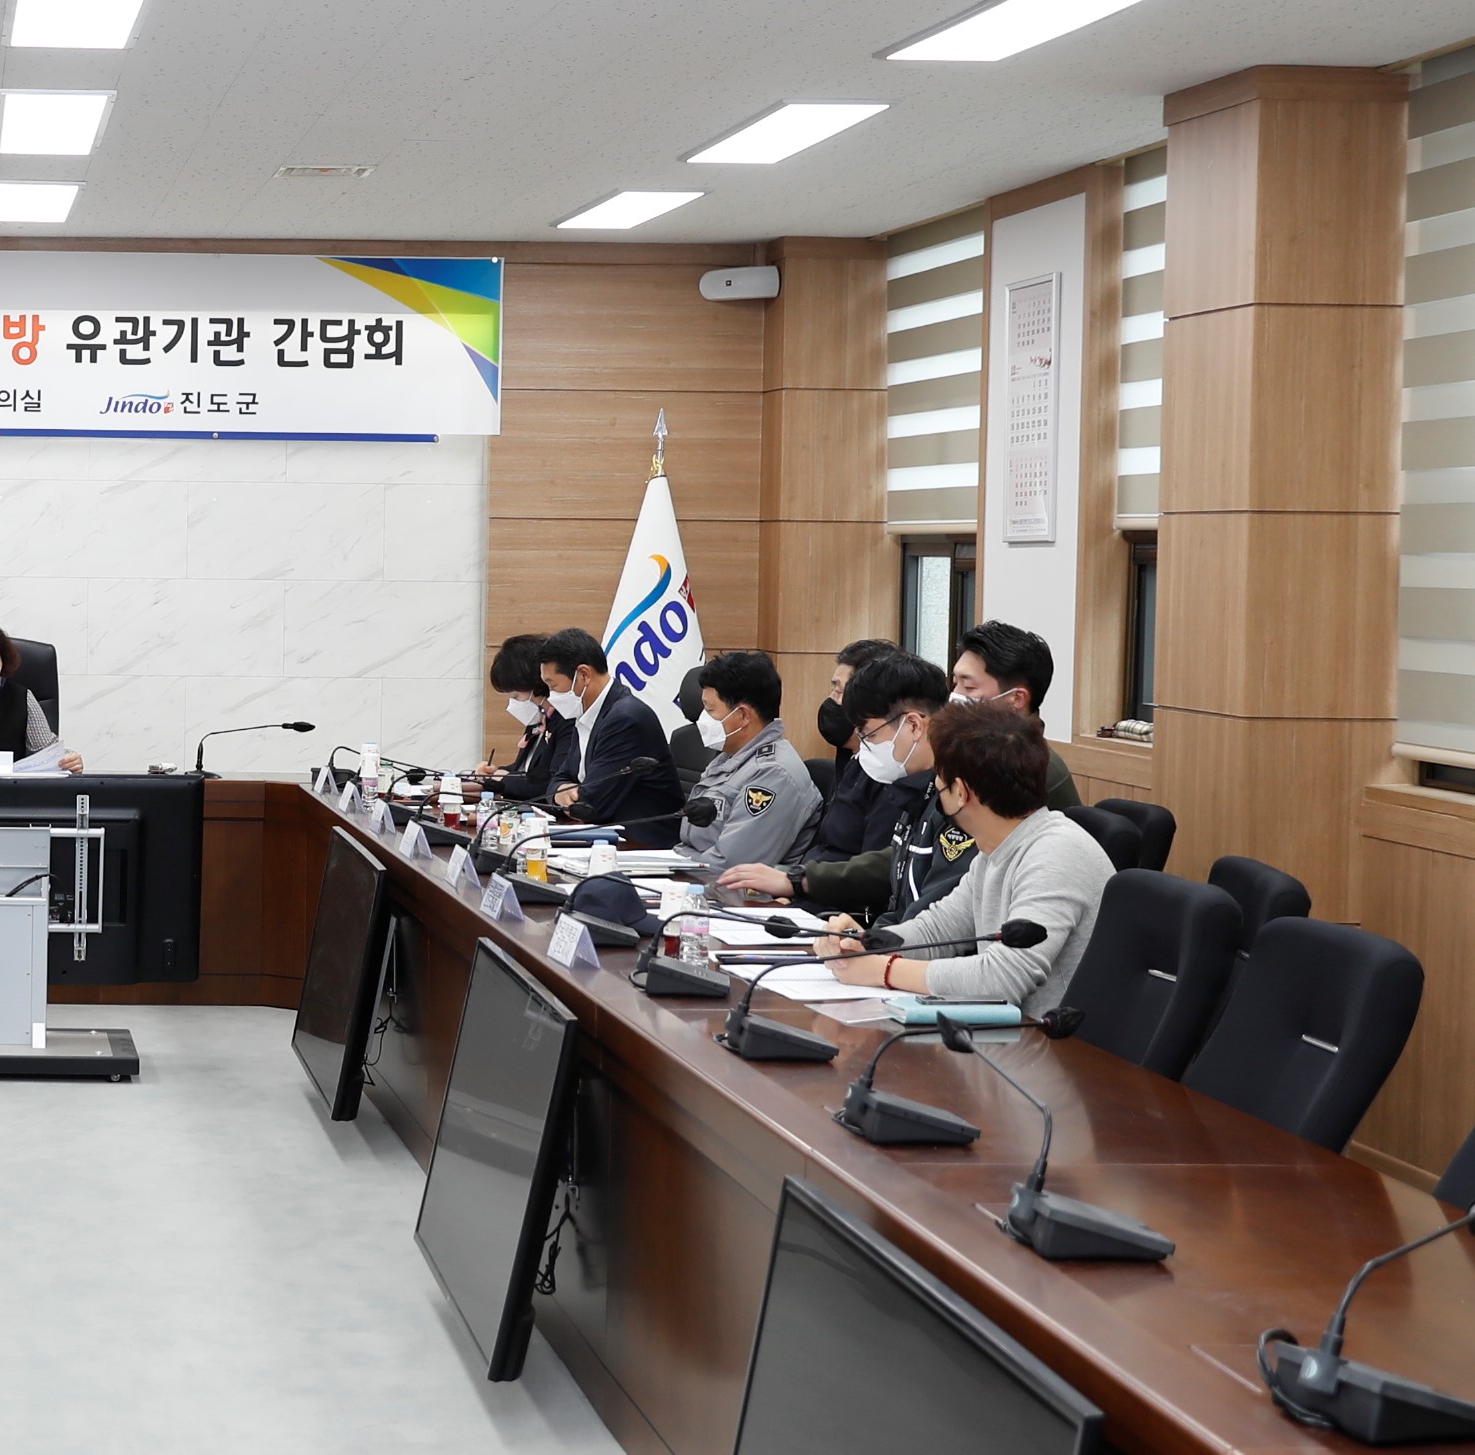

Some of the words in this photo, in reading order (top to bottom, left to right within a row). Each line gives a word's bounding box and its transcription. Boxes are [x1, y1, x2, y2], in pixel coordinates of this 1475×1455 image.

[66, 314, 251, 368] 유관기관
[273, 317, 404, 370] 간담회
[99, 396, 162, 415] Jindo
[179, 391, 260, 416] 진도군
[615, 601, 688, 692] ndo
